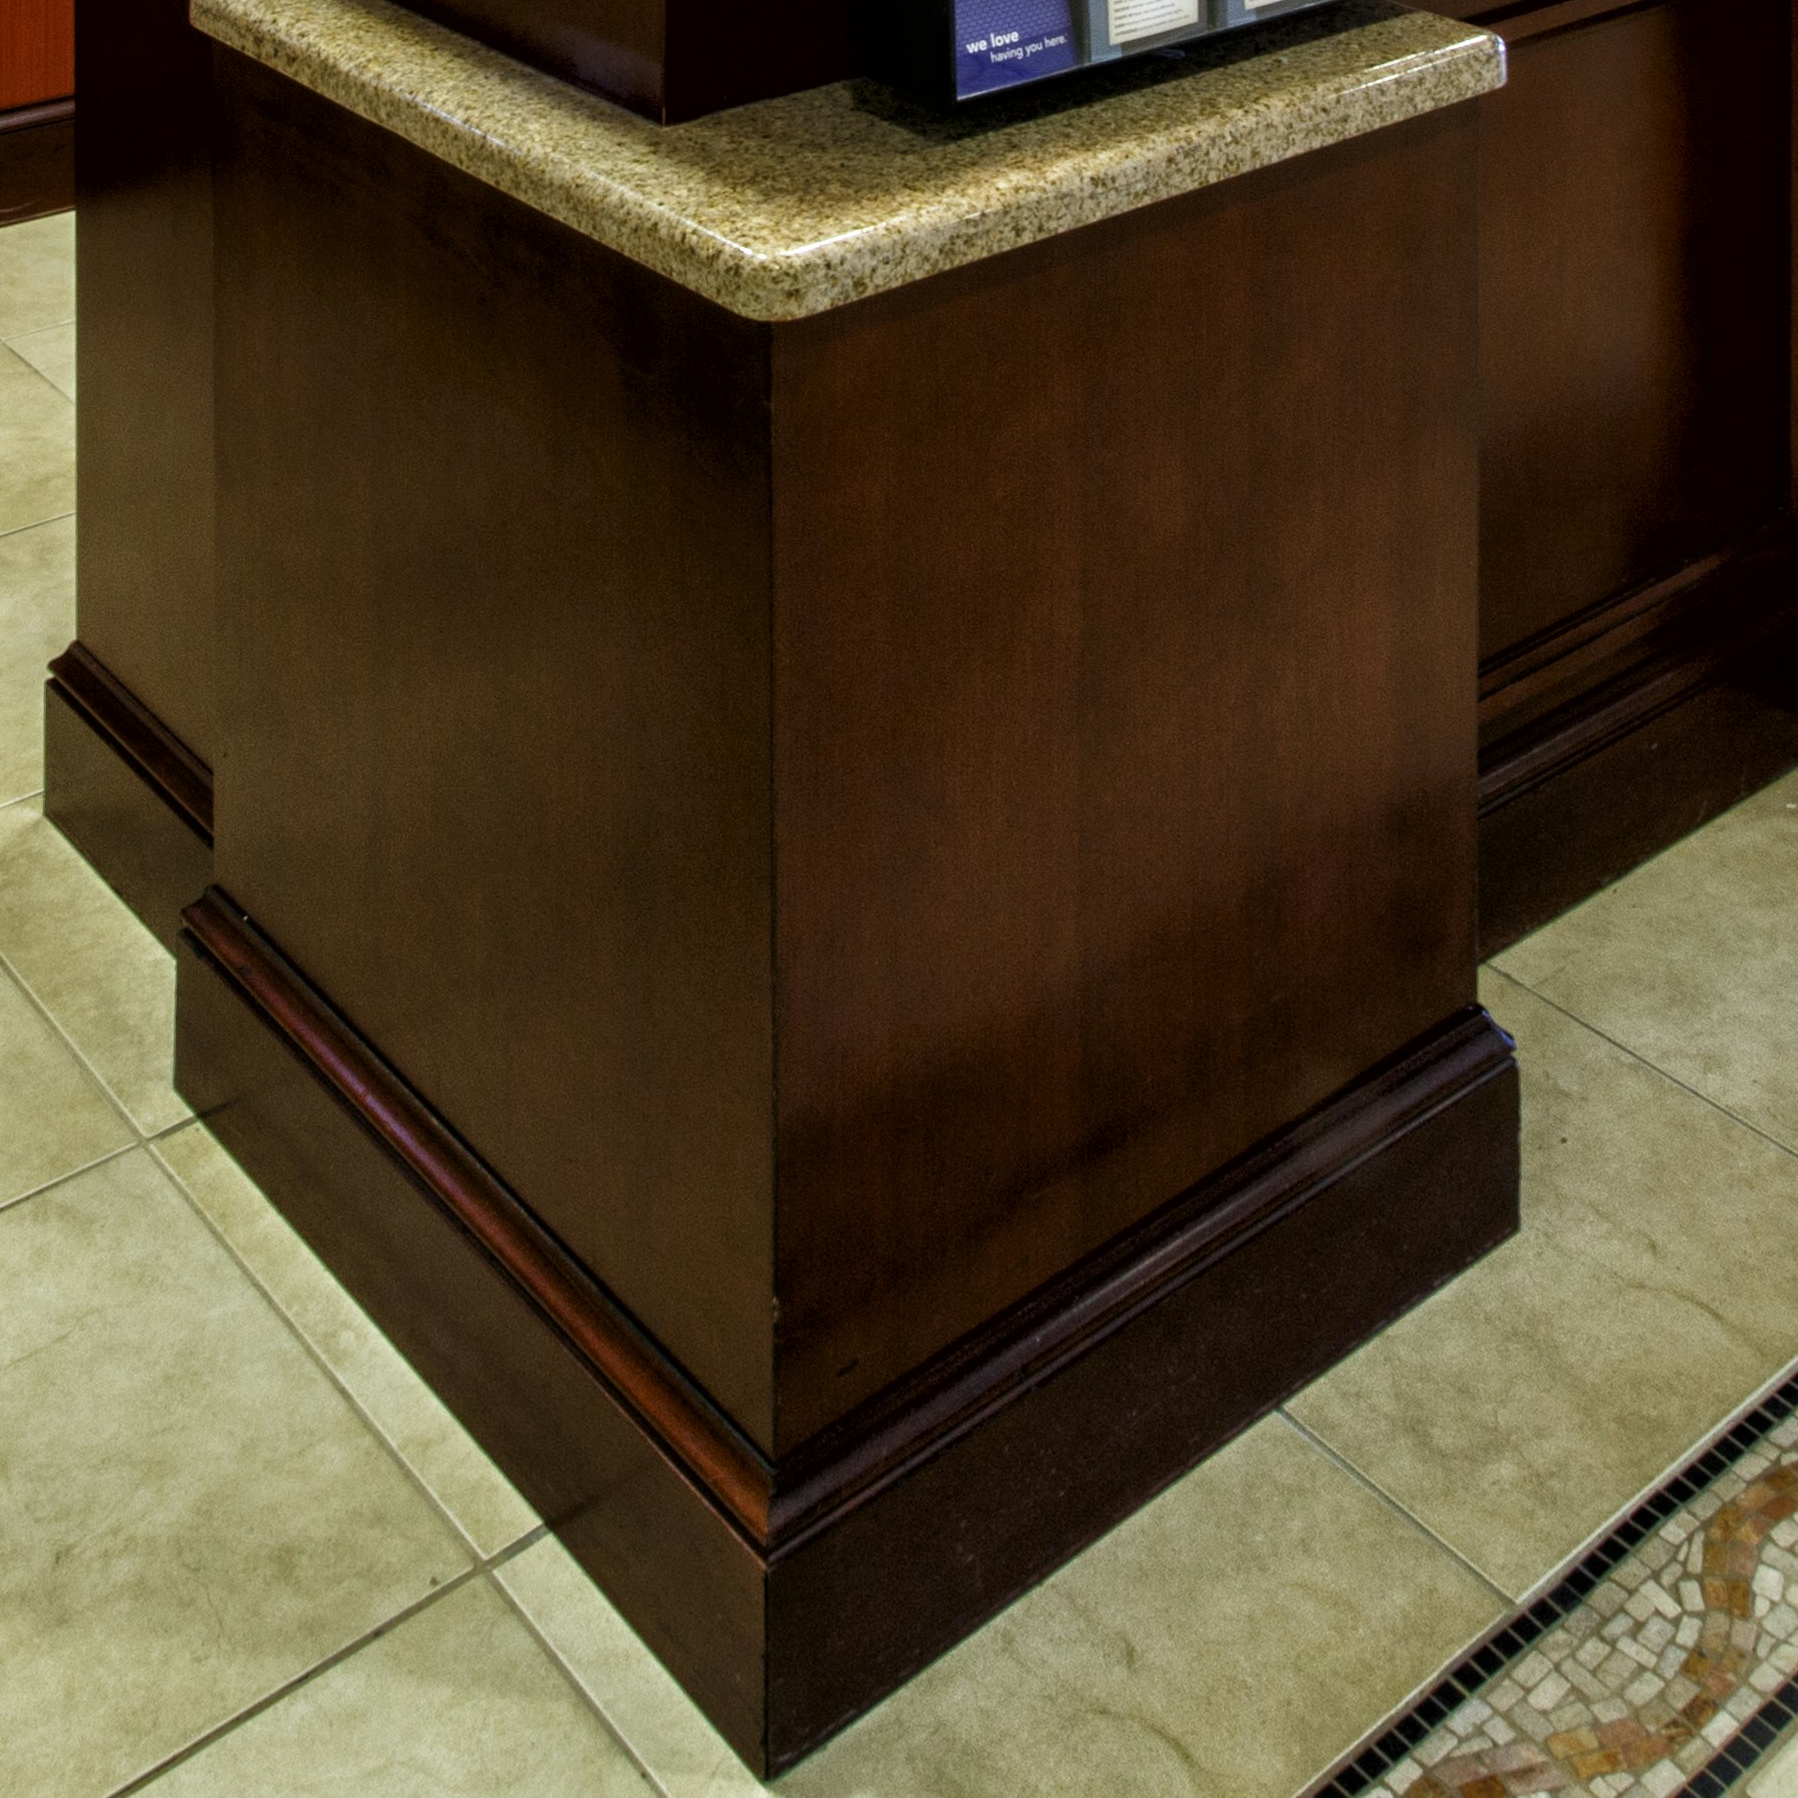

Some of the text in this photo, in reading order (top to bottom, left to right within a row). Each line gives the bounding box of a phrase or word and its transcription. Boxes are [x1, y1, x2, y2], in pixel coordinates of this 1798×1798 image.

[966, 31, 1020, 54] we love
[990, 46, 1023, 63] having
[1024, 41, 1043, 57] you
